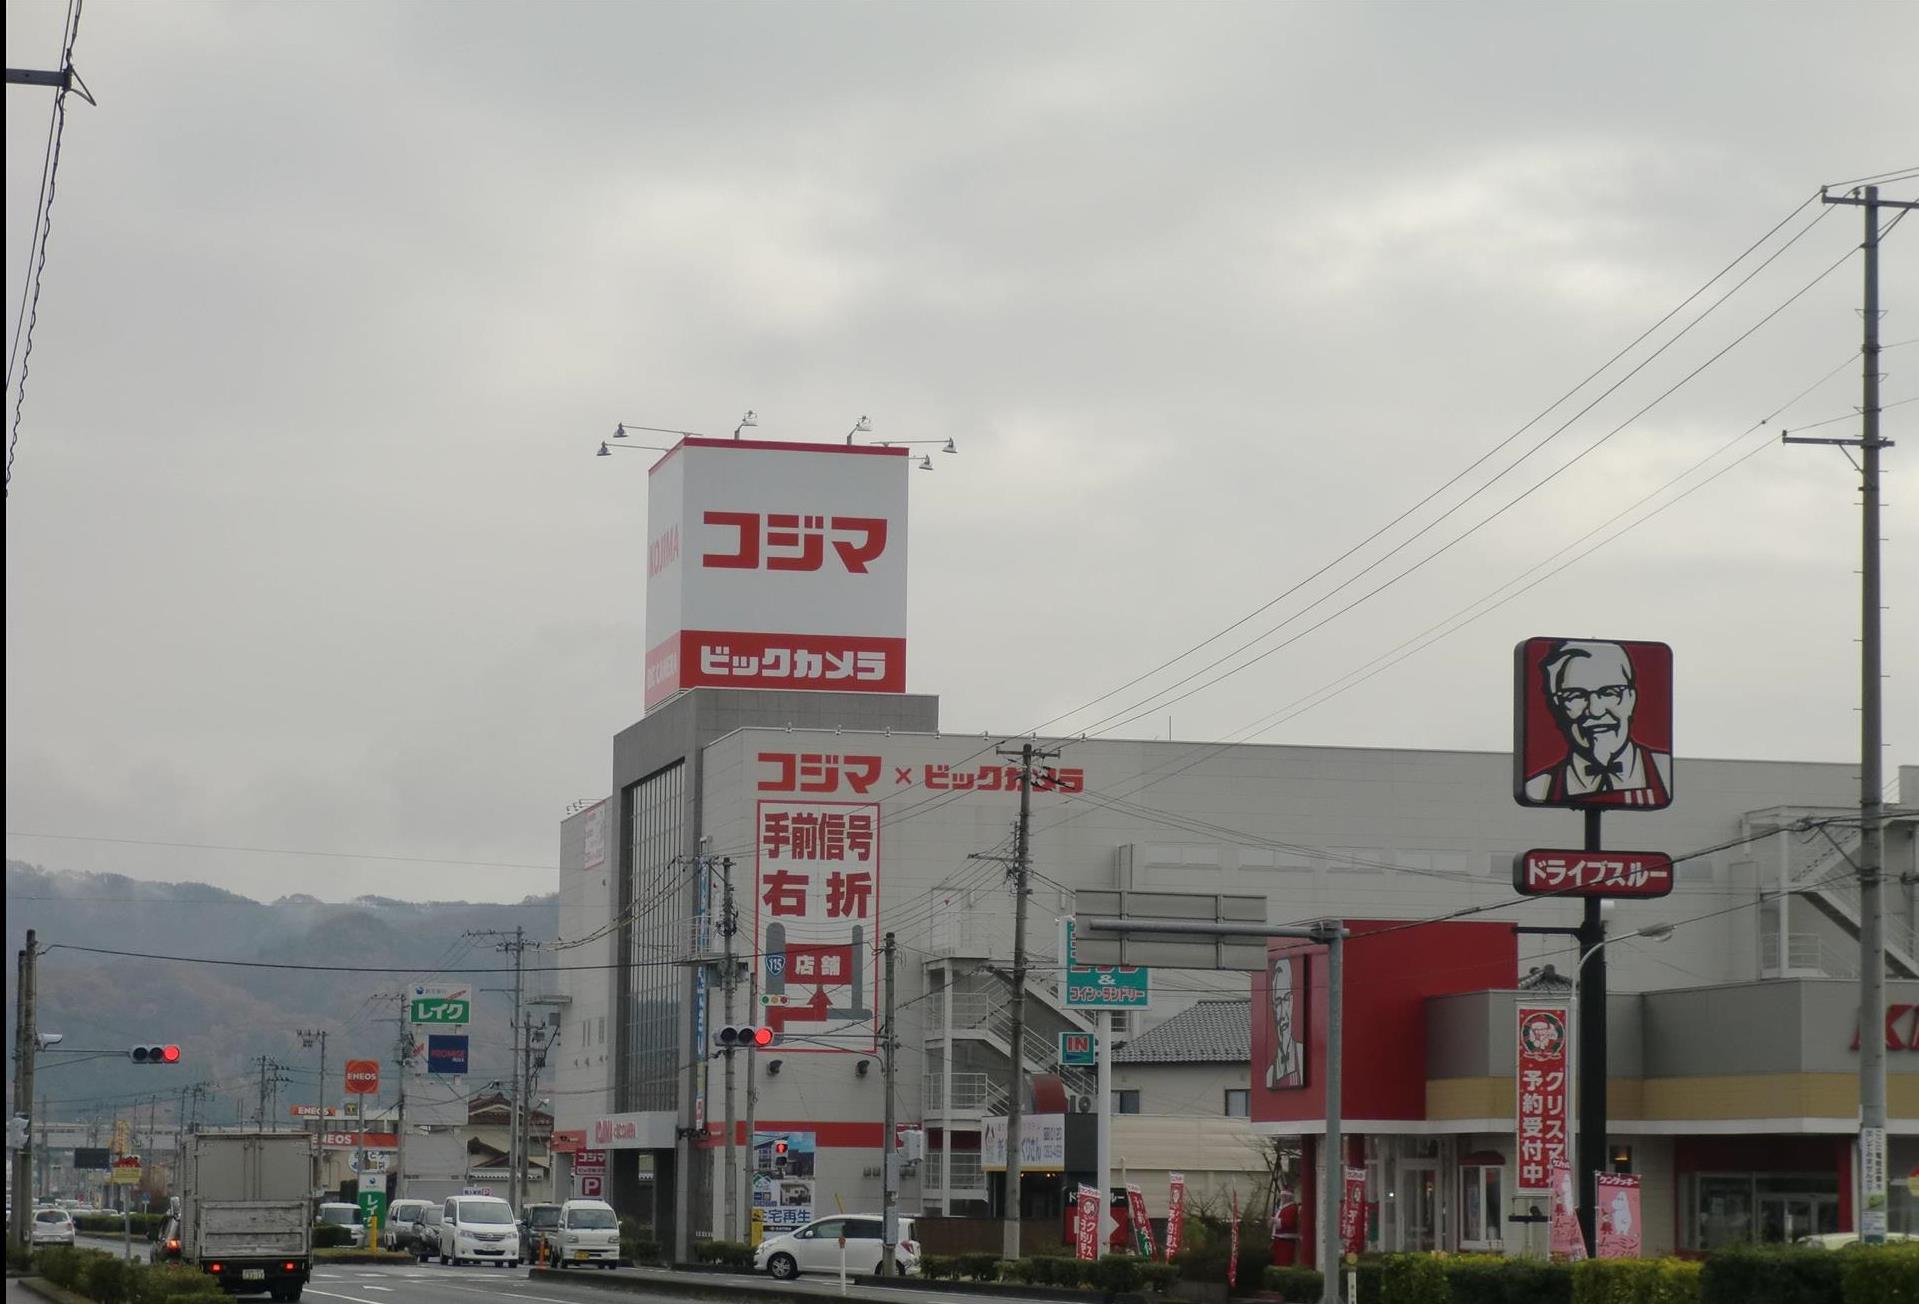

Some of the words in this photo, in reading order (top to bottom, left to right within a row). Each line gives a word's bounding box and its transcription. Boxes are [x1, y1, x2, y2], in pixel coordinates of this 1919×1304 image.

[703, 511, 887, 574] コジマ
[700, 645, 887, 681] ビックカメラ
[757, 752, 881, 793] コジマ
[763, 812, 873, 861] 手前信号
[795, 955, 841, 977] 店舗
[418, 1003, 464, 1020] レイク
[1067, 1037, 1089, 1052] IN
[347, 1072, 377, 1081] ENEOS
[1522, 1070, 1543, 1184] 予約受付中
